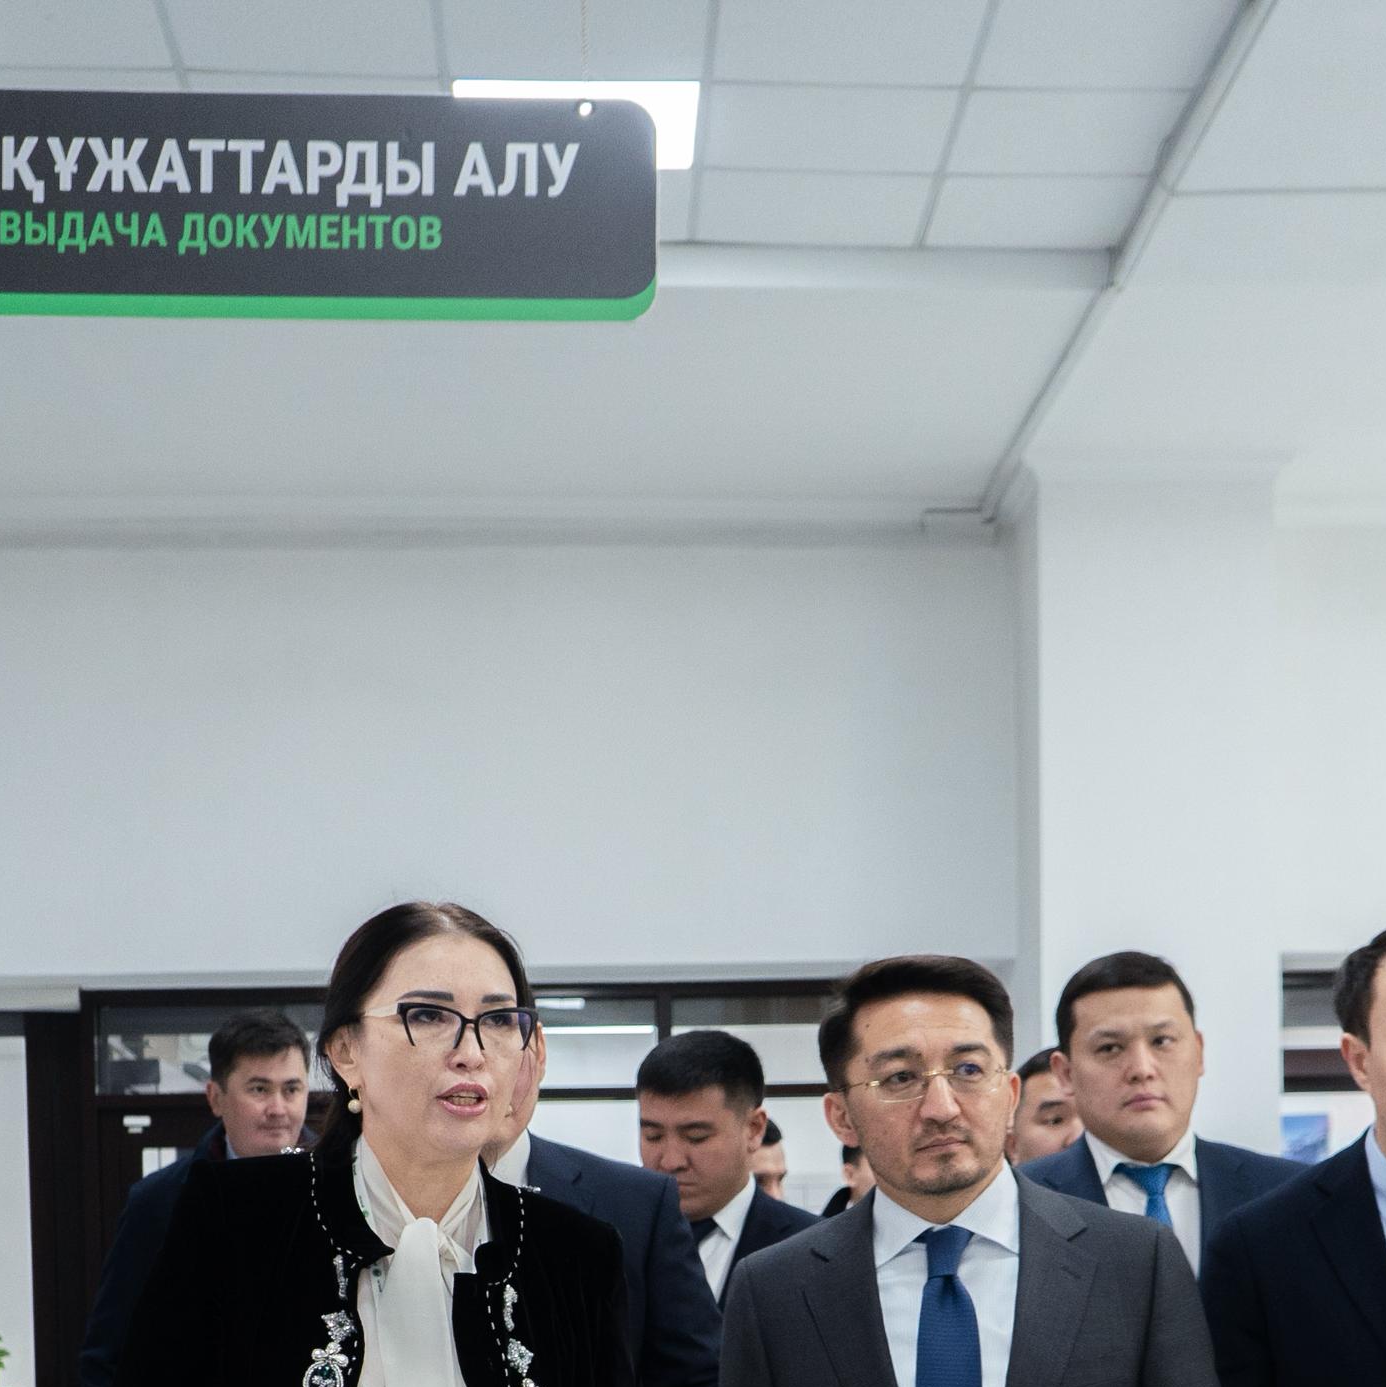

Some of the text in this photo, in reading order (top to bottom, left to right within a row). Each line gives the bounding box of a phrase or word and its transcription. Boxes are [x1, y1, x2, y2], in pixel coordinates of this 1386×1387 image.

[0, 136, 580, 207] ҚҰЖАТТАРДЫ АЛУ
[177, 213, 443, 257] ДОКУМЕНТОВ
